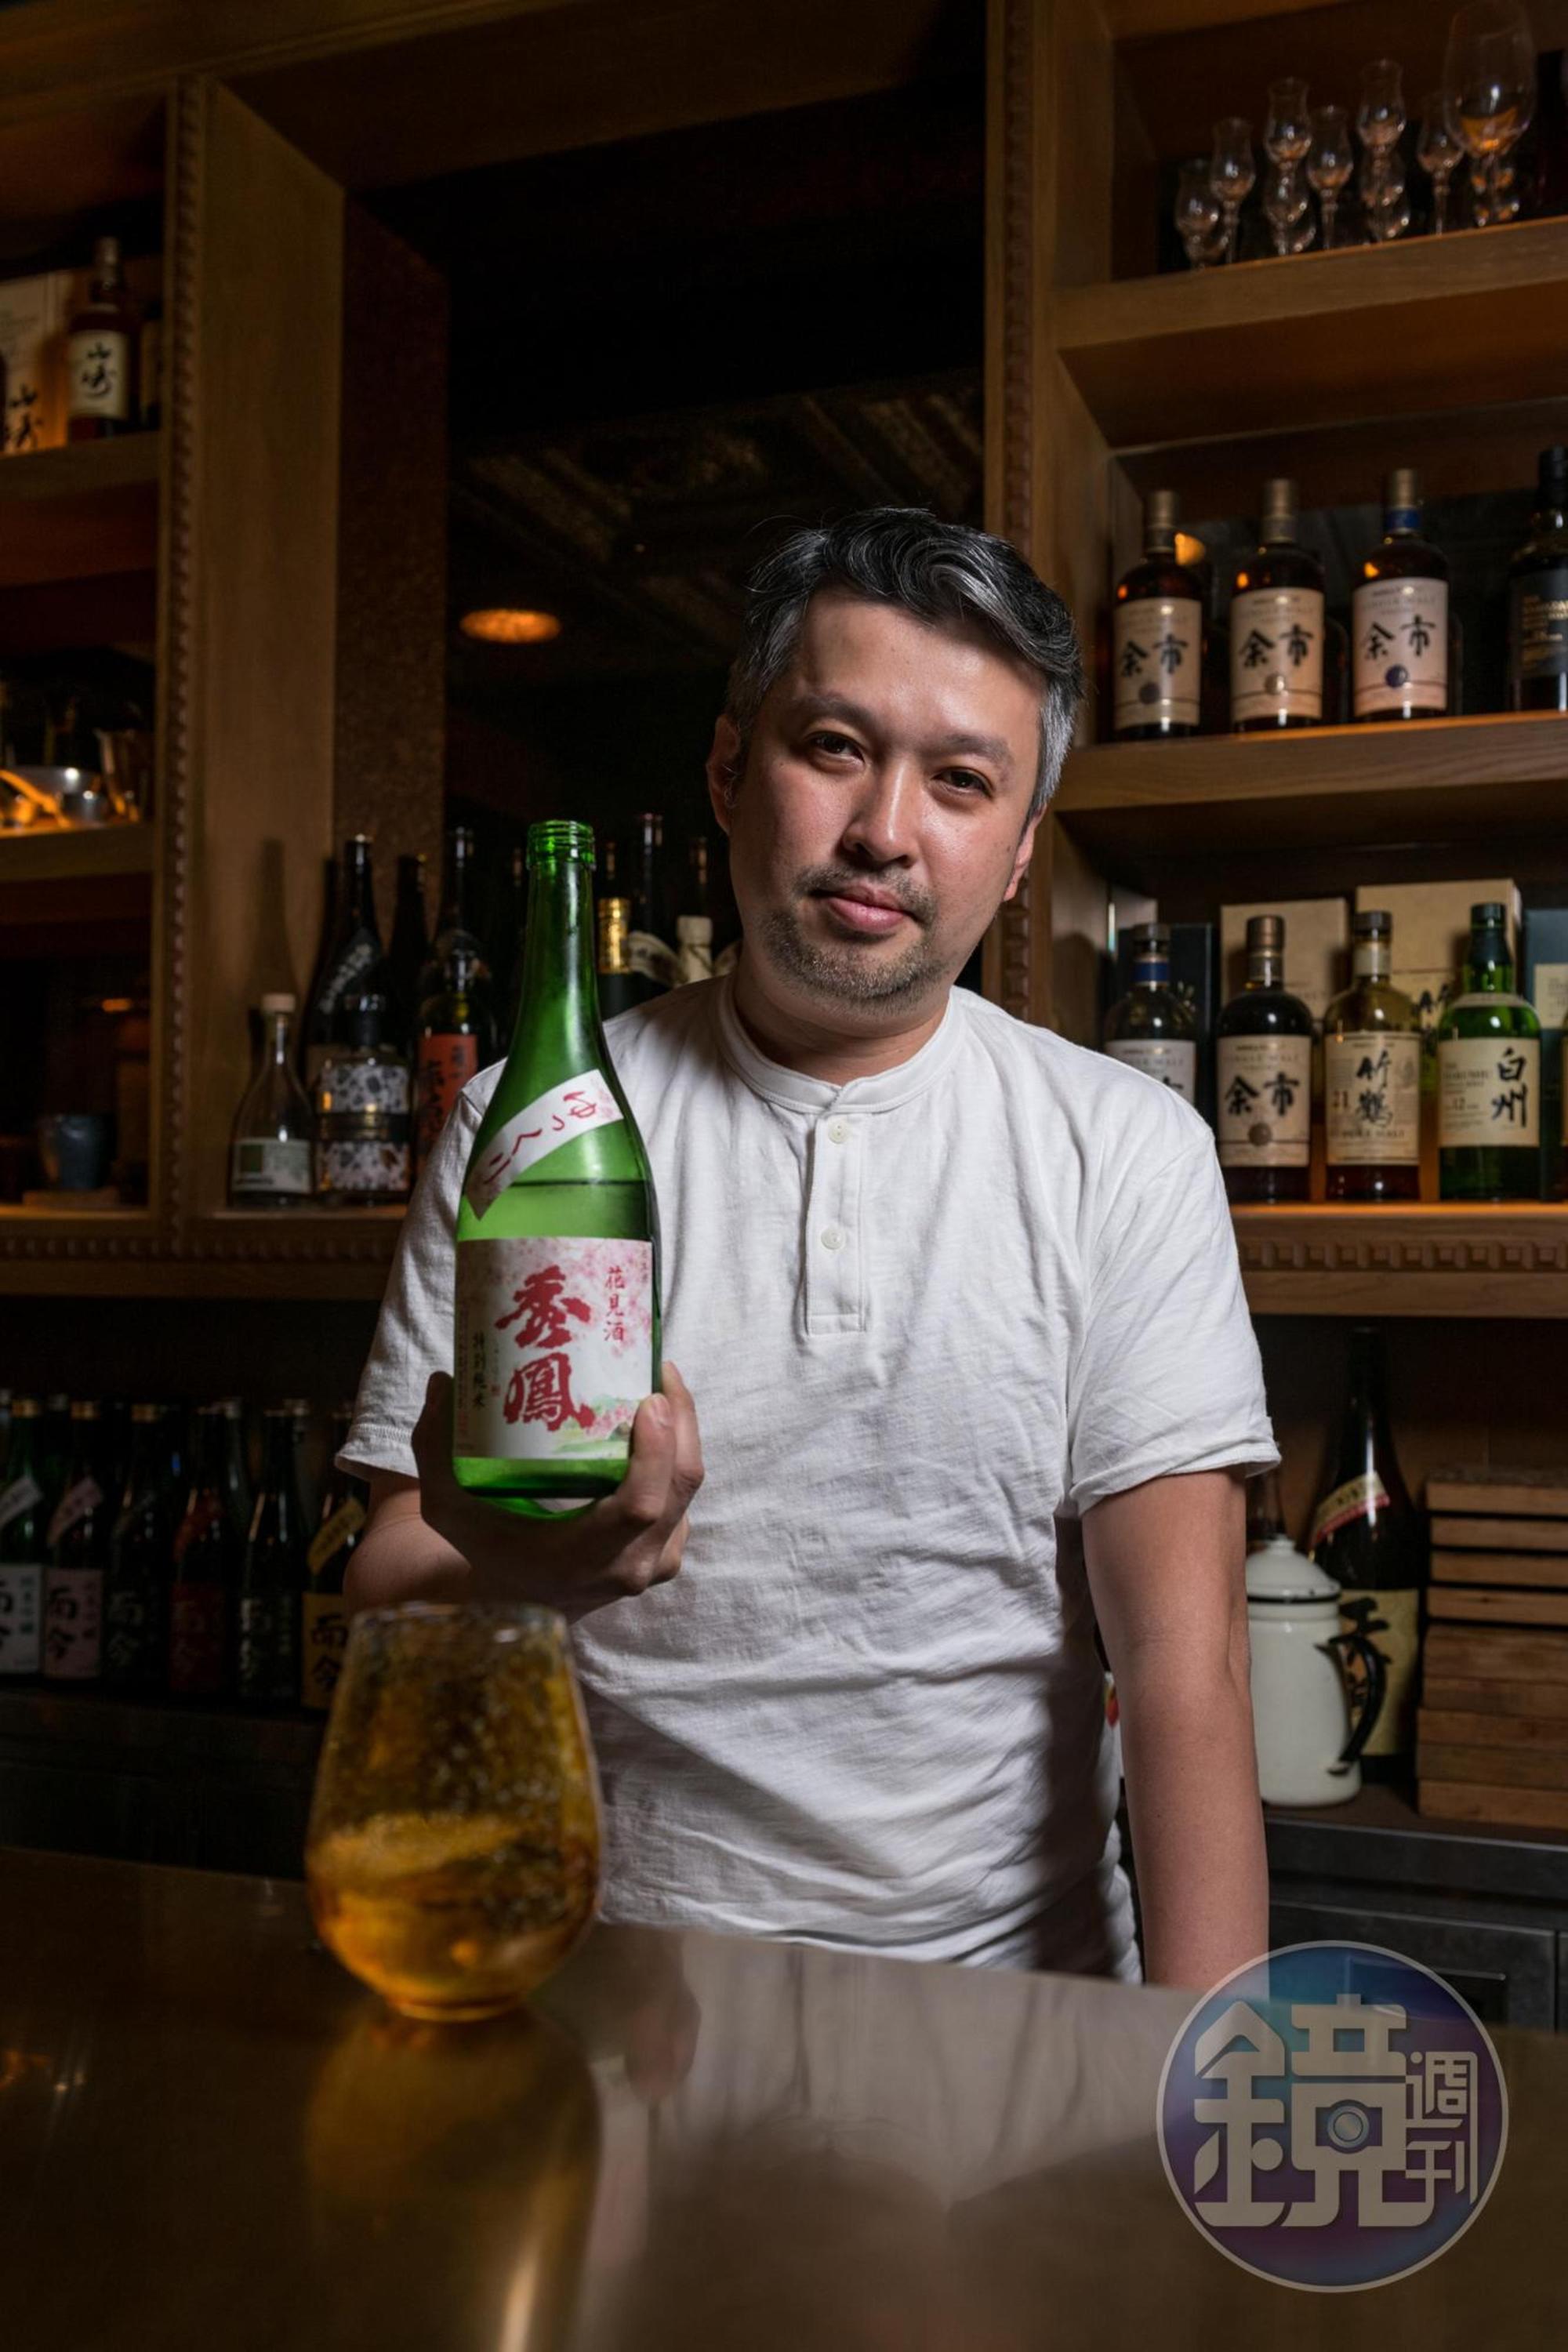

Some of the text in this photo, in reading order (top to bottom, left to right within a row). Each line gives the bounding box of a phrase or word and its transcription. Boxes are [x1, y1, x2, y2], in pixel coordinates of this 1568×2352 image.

[1120, 633, 1189, 677] 余市
[1239, 624, 1313, 668] 余市
[1364, 615, 1436, 660] 余市
[1224, 1072, 1300, 1116] 余市
[1356, 1049, 1393, 1127] 竹鶴
[1491, 1047, 1528, 1127] 白州
[604, 1265, 625, 1342] 花見酒
[494, 1265, 596, 1432] 秀鳳
